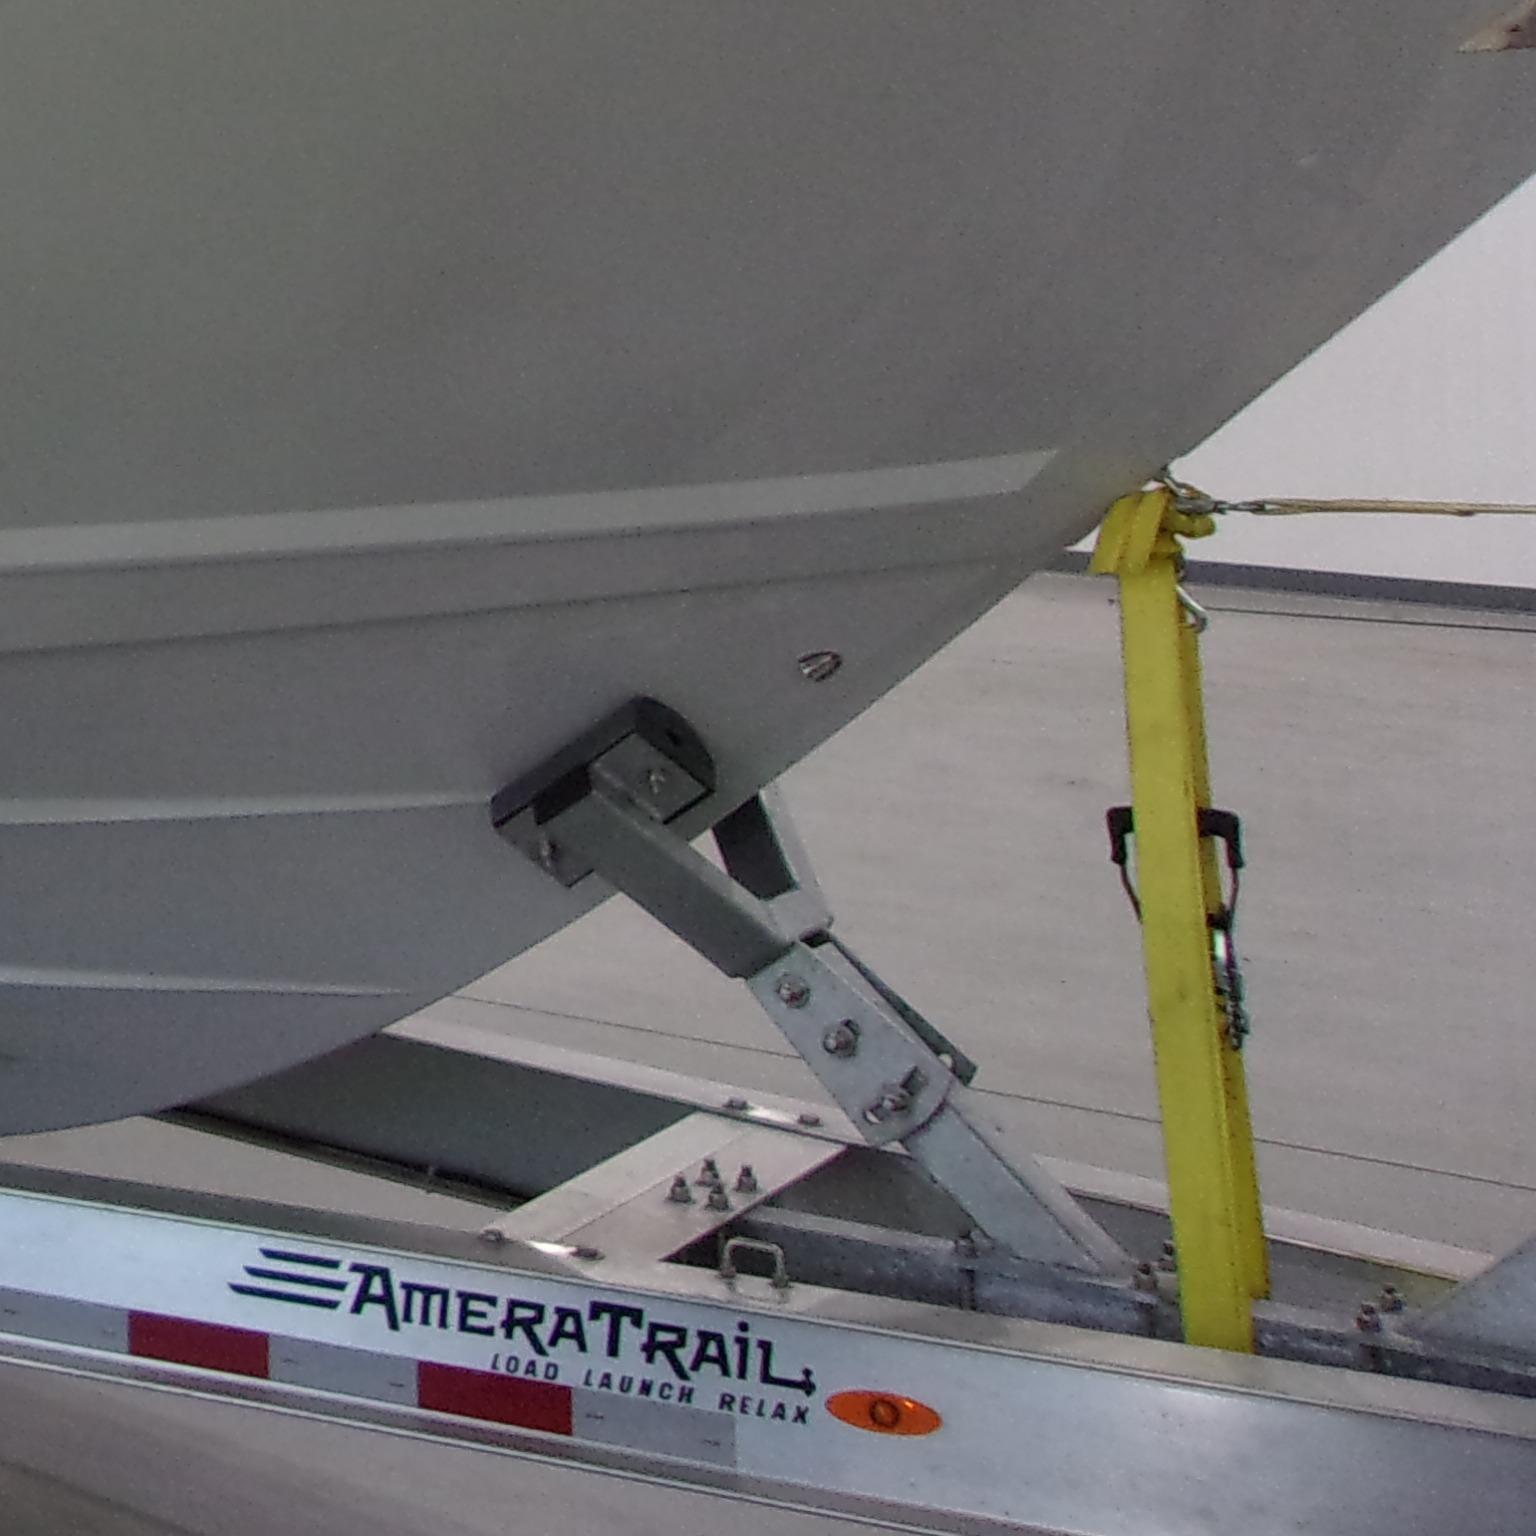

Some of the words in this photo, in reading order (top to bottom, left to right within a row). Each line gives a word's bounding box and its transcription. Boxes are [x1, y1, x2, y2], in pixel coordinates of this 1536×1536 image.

[490, 1352, 560, 1382] LOAD
[583, 1368, 695, 1404] LAUNCH
[718, 1392, 810, 1425] RELAX
